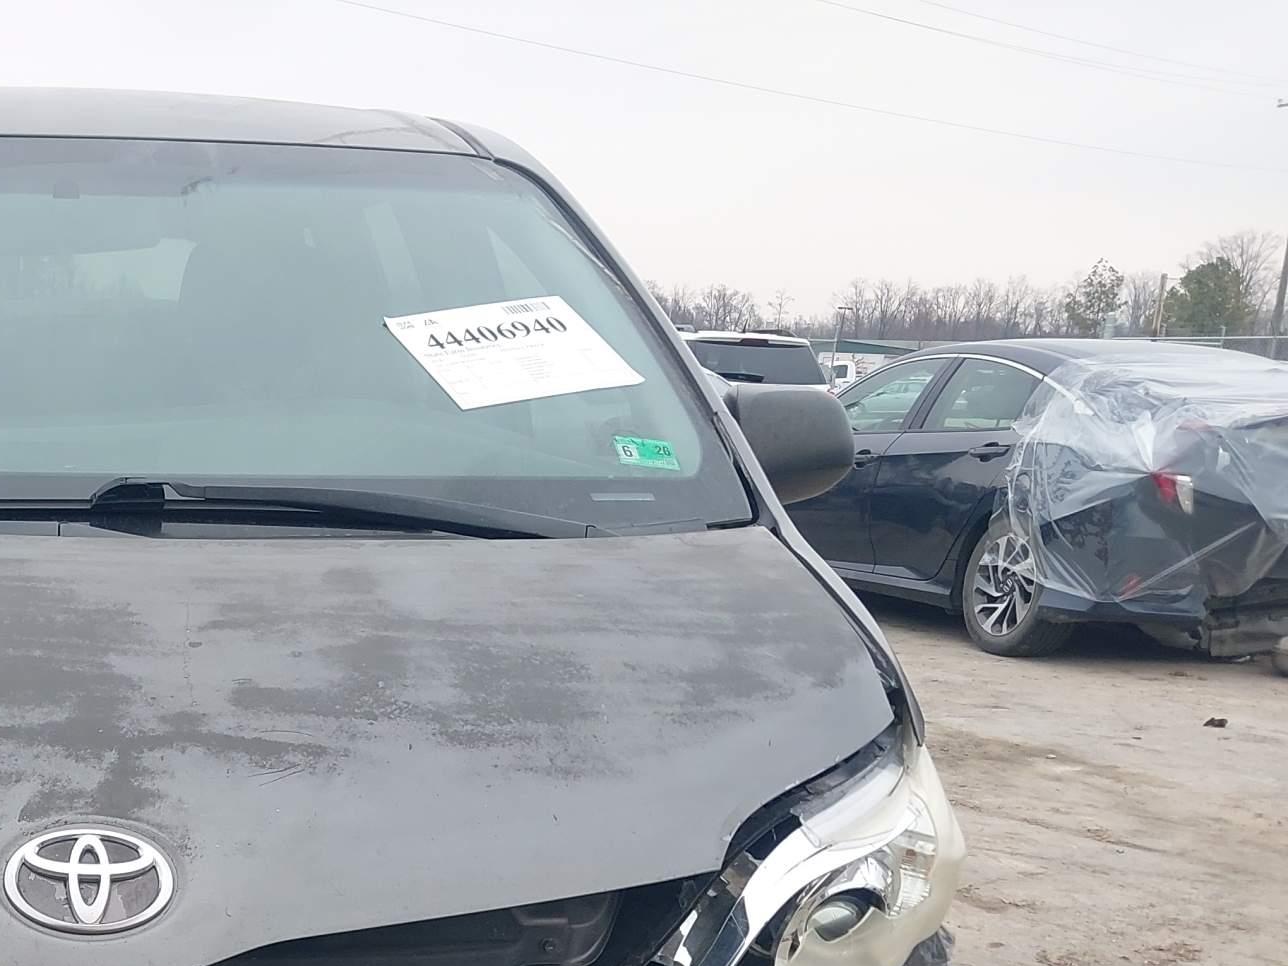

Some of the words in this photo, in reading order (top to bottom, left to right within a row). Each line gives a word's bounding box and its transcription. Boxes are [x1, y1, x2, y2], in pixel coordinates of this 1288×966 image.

[427, 316, 568, 350] 44406940
[621, 445, 633, 457] 6
[655, 445, 671, 457] 26
